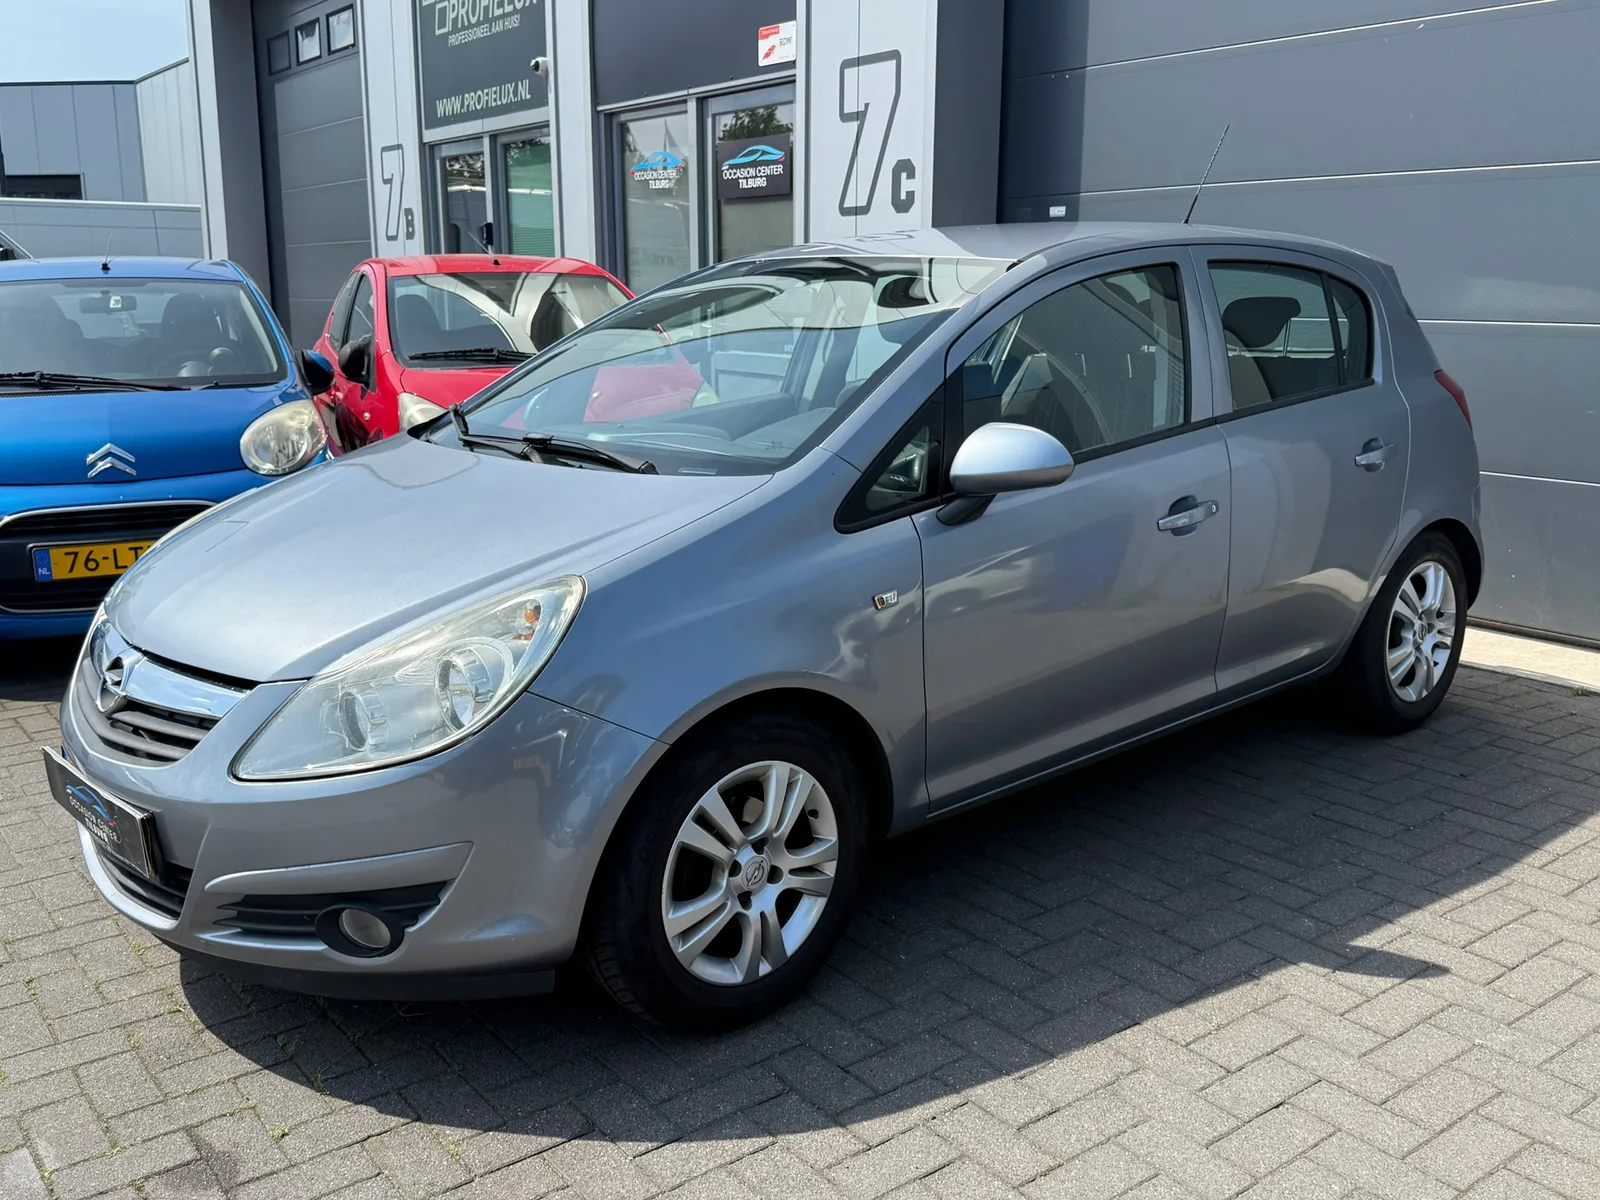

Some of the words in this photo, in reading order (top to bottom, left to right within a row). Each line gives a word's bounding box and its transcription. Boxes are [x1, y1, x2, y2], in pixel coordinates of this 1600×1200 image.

[447, 0, 537, 31] PROFIE
[448, 24, 491, 47] PROFESSIONEEL
[491, 18, 504, 34] AAN
[504, 14, 520, 30] HUIS!
[436, 79, 531, 118] WWW.PROFIELUX.NL
[634, 171, 657, 180] OCCASION
[657, 169, 677, 179] CENTER
[722, 167, 756, 180] OCCASION
[756, 164, 784, 177] CENTER
[738, 177, 767, 189] TILBURG
[649, 179, 670, 189] TILBURG
[64, 545, 152, 573] 76-LT
